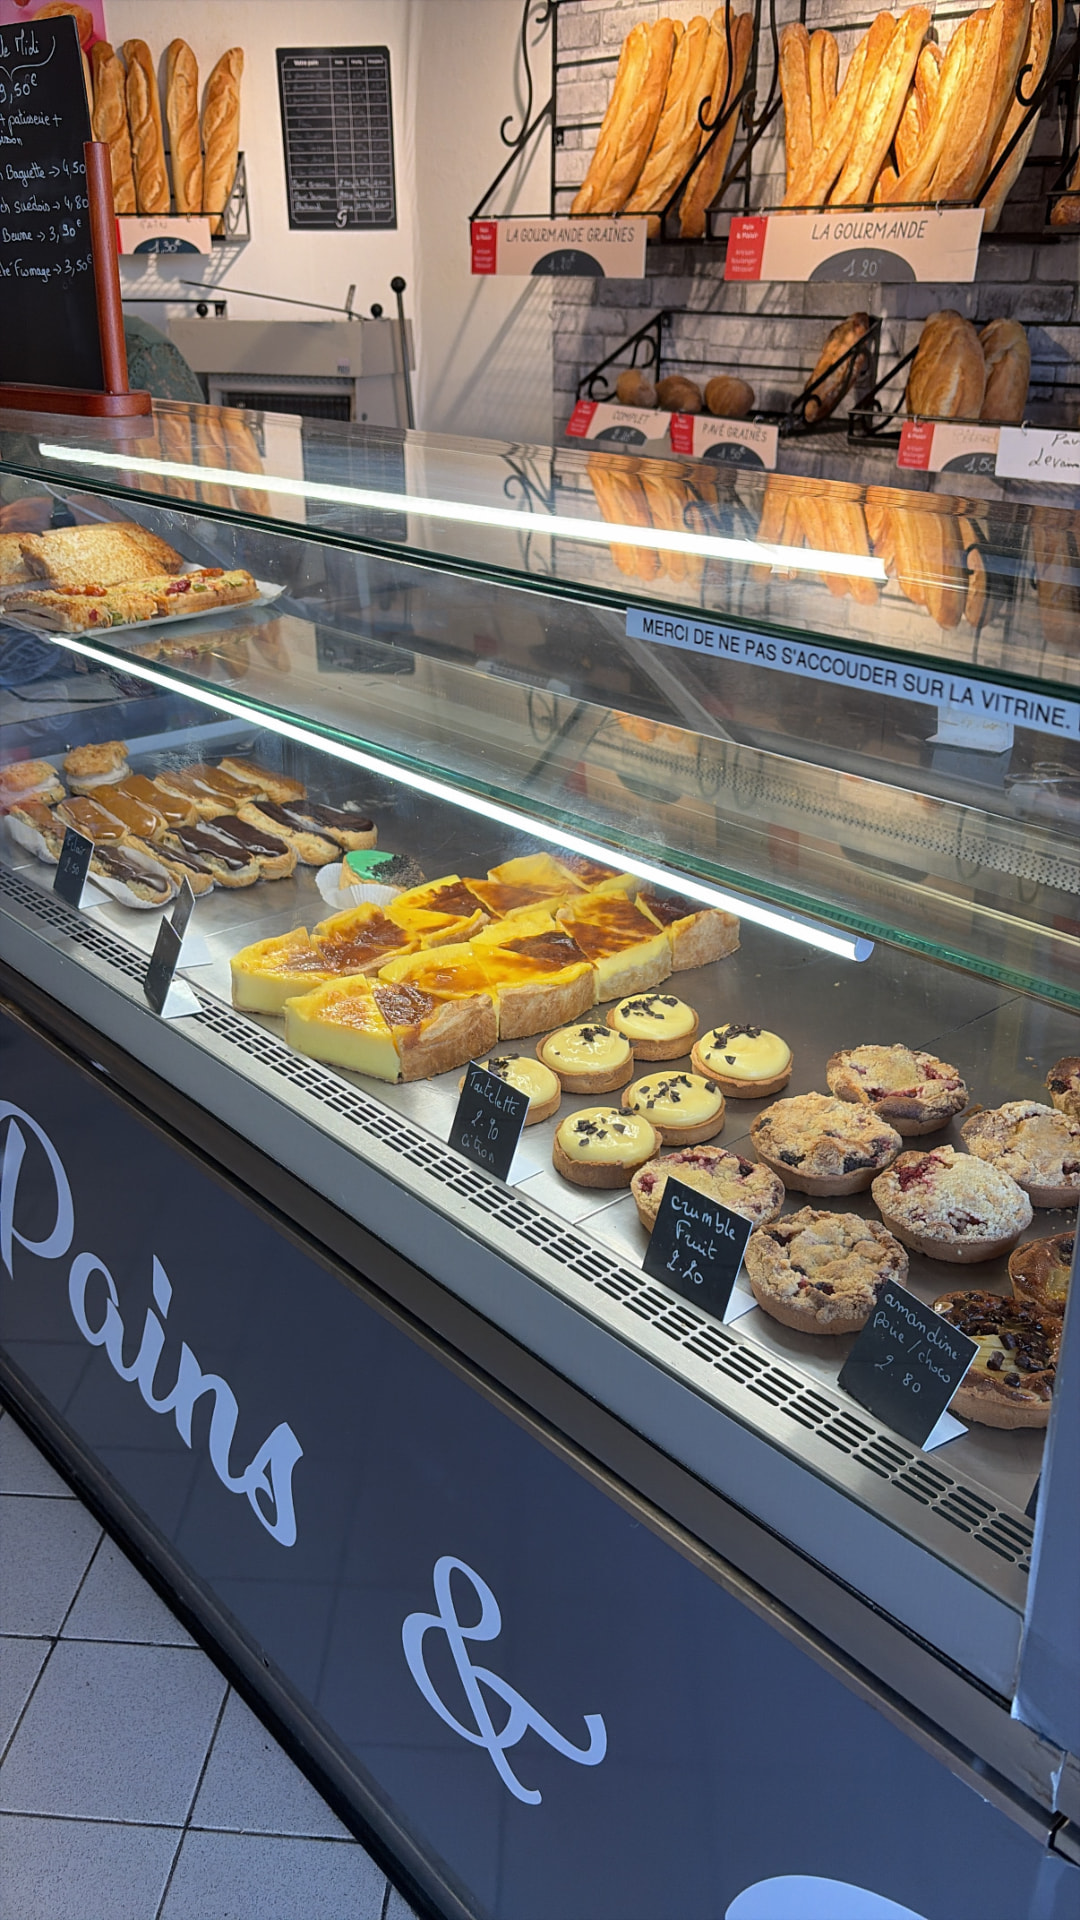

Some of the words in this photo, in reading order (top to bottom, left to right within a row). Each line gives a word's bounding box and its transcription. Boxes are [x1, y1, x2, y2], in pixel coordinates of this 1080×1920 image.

[15, 28, 40, 56] Midi
[5, 162, 46, 188] Baguette
[14, 195, 51, 213] Suédois
[505, 228, 519, 242] LA
[520, 227, 582, 243] GOURMANDE
[586, 227, 635, 243] GRAINES
[811, 223, 829, 240] LA
[833, 220, 929, 240] GOURMANDE
[14, 258, 51, 283] Fromage
[702, 421, 725, 437] PAVÉ
[726, 426, 768, 442] GRAINES
[642, 617, 689, 642] MERCI
[693, 628, 715, 648] DE
[719, 633, 740, 654] NE
[745, 640, 777, 661] PAS
[781, 647, 897, 688] S'ACCOUDER
[903, 673, 944, 698] SUR
[949, 683, 974, 706] LA
[981, 690, 1071, 730] VITRINE.
[470, 1071, 520, 1116] Tartelette
[0, 1104, 304, 1547] Pains
[884, 1293, 958, 1360] amandine
